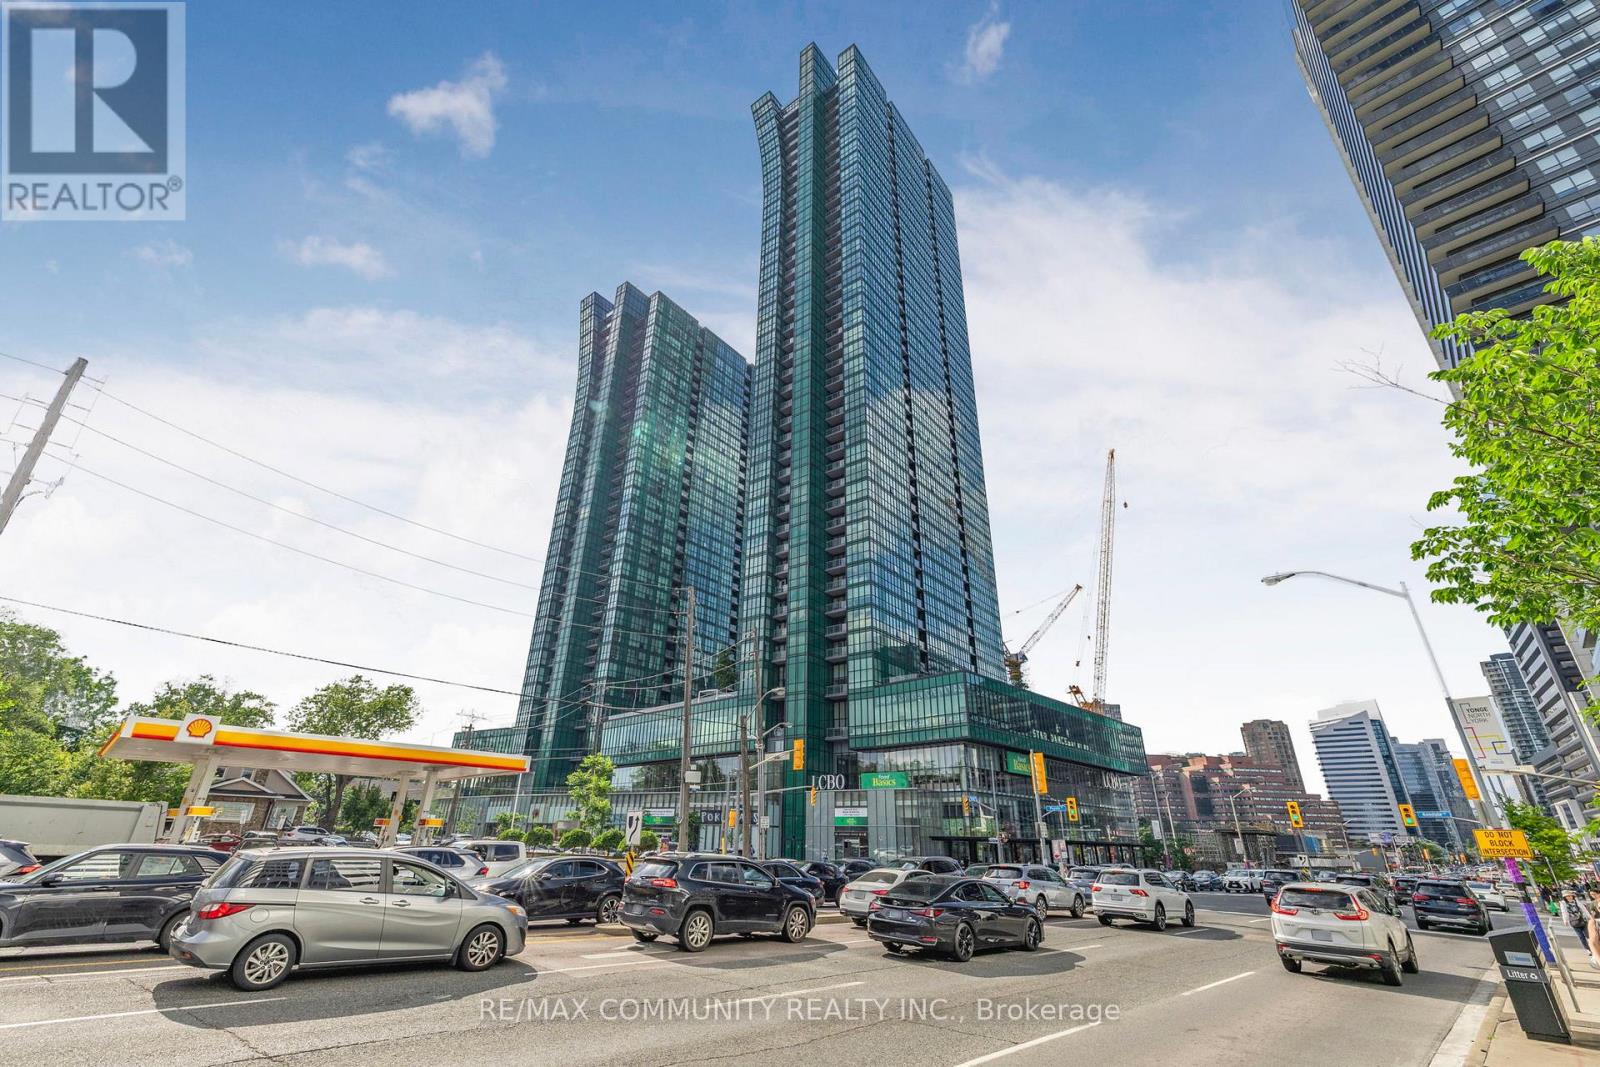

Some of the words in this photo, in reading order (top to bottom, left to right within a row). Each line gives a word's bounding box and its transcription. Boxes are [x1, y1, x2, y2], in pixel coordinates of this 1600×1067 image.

[812, 773, 845, 790] LCBO
[872, 777, 896, 787] Basics
[1490, 839, 1514, 847] BLOCK
[1482, 848, 1529, 856] INTERSECTION
[1506, 969, 1529, 979] Litter
